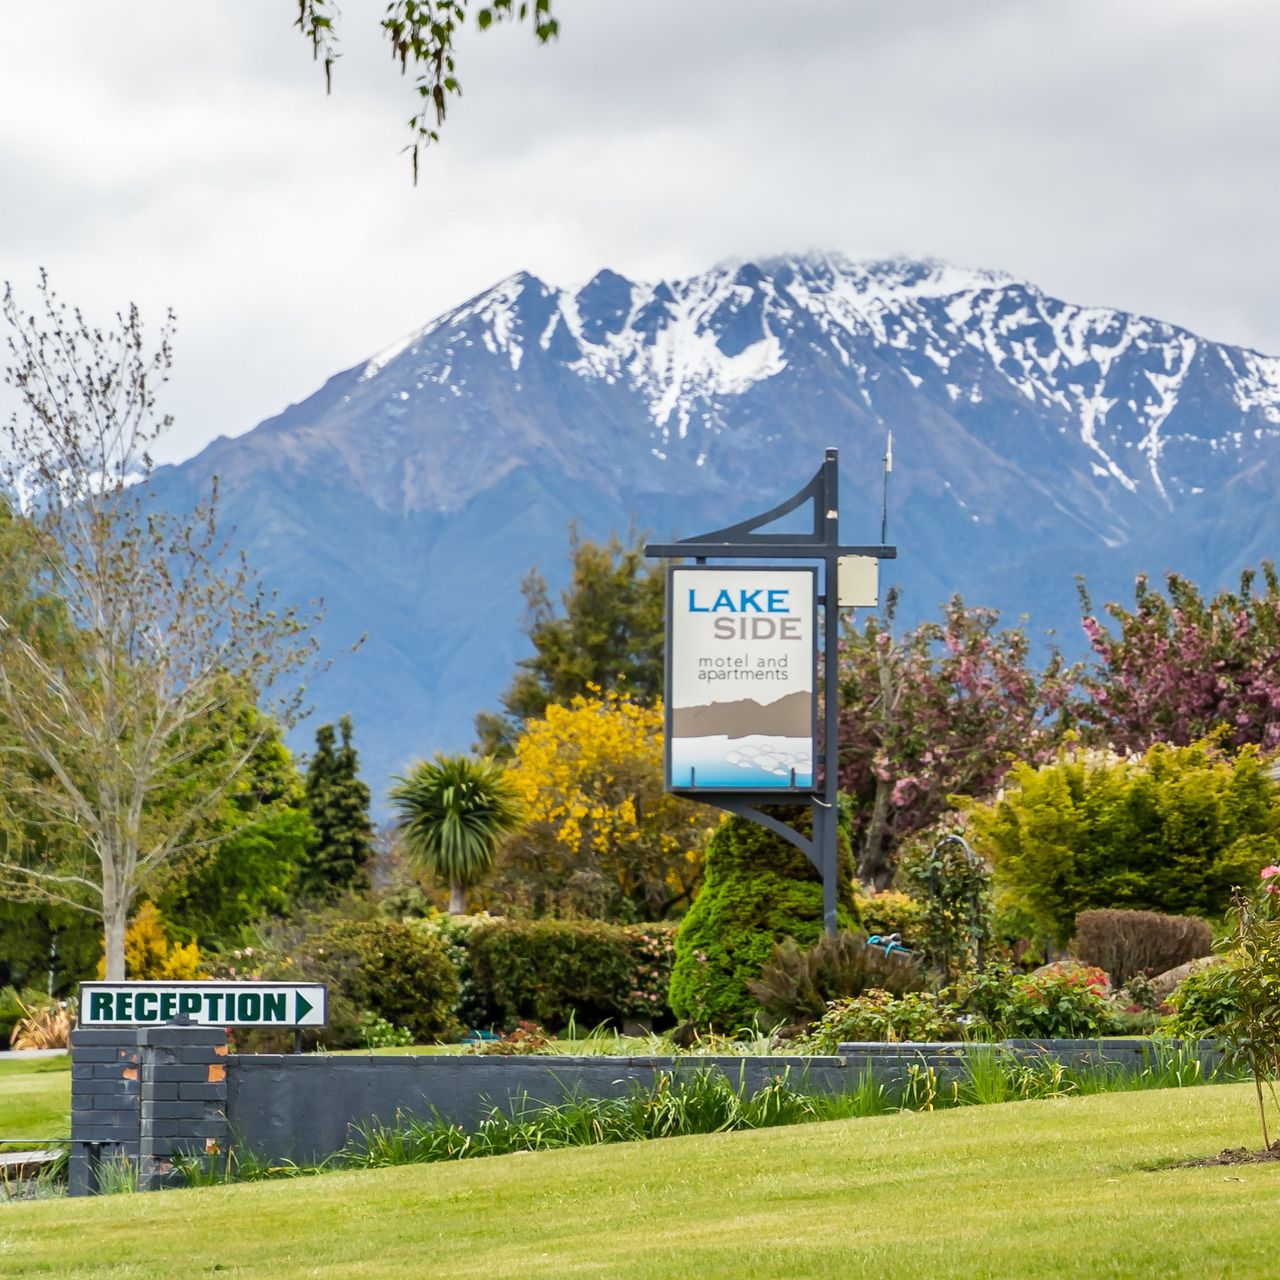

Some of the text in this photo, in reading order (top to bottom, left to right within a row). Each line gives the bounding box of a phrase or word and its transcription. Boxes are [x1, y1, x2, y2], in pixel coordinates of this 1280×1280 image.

[688, 589, 790, 612] LAKE
[714, 617, 802, 640] SIDE
[698, 654, 788, 668] motel and
[698, 669, 788, 683] apartments
[90, 992, 287, 1021] RECEPTION
